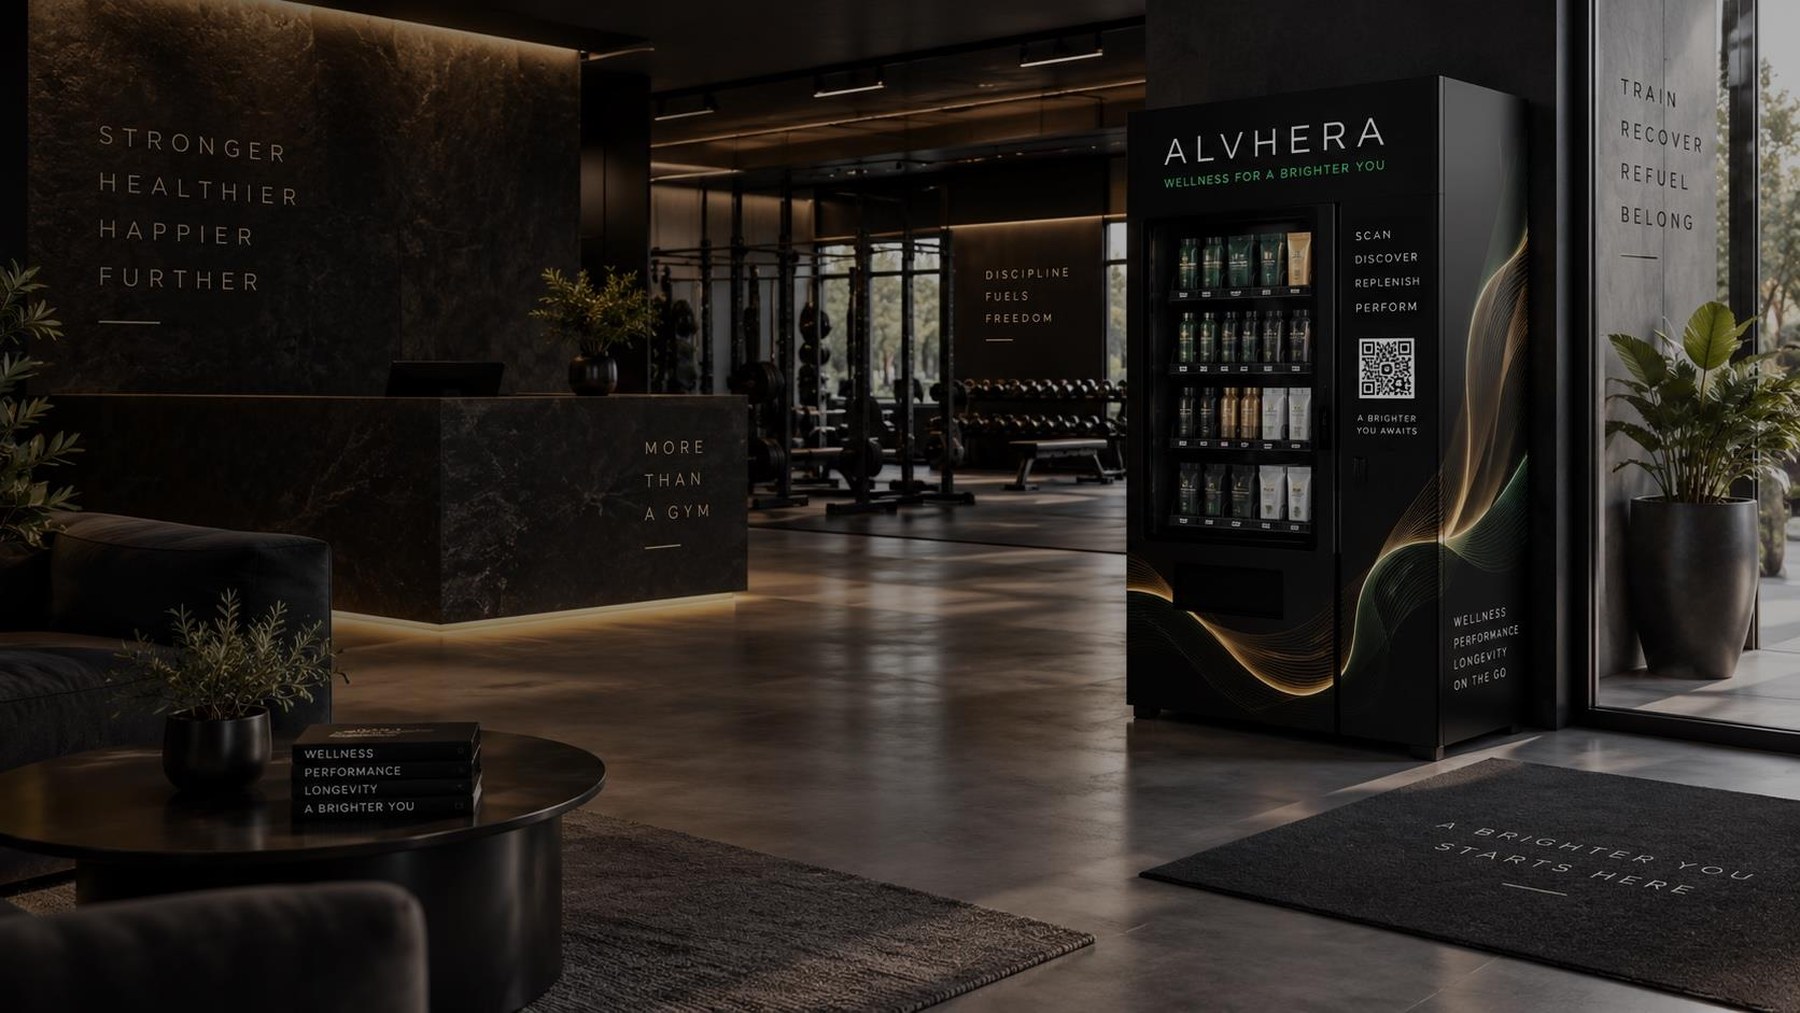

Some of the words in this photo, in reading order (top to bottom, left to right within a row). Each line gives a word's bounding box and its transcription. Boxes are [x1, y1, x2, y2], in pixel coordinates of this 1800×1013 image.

[1620, 78, 1676, 108] TRAIN
[98, 125, 286, 164] STRONGER
[1164, 117, 1385, 166] ALVHERA
[1621, 120, 1702, 153] RECOVER
[1164, 173, 1230, 188] WELLNESS
[1234, 170, 1261, 182] FOR
[1266, 169, 1275, 180] A
[1280, 163, 1350, 179] BRIGHTER
[1355, 159, 1386, 172] YOU
[1621, 162, 1689, 191] REFUEL
[98, 172, 298, 206] HEALTHIER
[1621, 206, 1693, 230] BELONG
[98, 219, 254, 247] HAPPIER
[1355, 230, 1392, 241] SCAN
[1355, 252, 1418, 264] DISCOVER
[98, 266, 260, 292] FURTHER
[985, 267, 1070, 280] DISCIPLINE
[1354, 276, 1421, 288] REPLENISH
[985, 291, 1029, 302] FUELS
[1355, 301, 1418, 313] PERFORM
[985, 313, 1053, 323] FREEDOM
[1357, 414, 1364, 422] A
[1367, 414, 1417, 423] BRIGHTER
[1356, 427, 1377, 436] YOU
[1380, 427, 1418, 436] AWAITS
[645, 439, 705, 455] MORE
[645, 471, 702, 488] THAN
[644, 506, 656, 521] A
[667, 504, 711, 520] GYM
[1453, 606, 1507, 627] WELLNESS
[1453, 624, 1520, 649] PERFORMANCE
[1453, 647, 1508, 670] LONGEVITY
[1453, 678, 1468, 691] ON
[1472, 671, 1490, 687] THE
[1493, 668, 1507, 681] GO
[304, 748, 374, 759] WELLNESS
[304, 766, 401, 778] PERFORMANCE
[304, 784, 378, 796] LONGEVITY
[304, 804, 314, 814] A
[318, 802, 384, 814] BRIGHTER
[387, 801, 415, 812] YOU
[1435, 821, 1456, 831] A
[1474, 827, 1655, 864] BRIGHTER
[1678, 860, 1755, 881] YOU
[1434, 842, 1573, 873] STARTS
[1590, 871, 1695, 896] HERE
